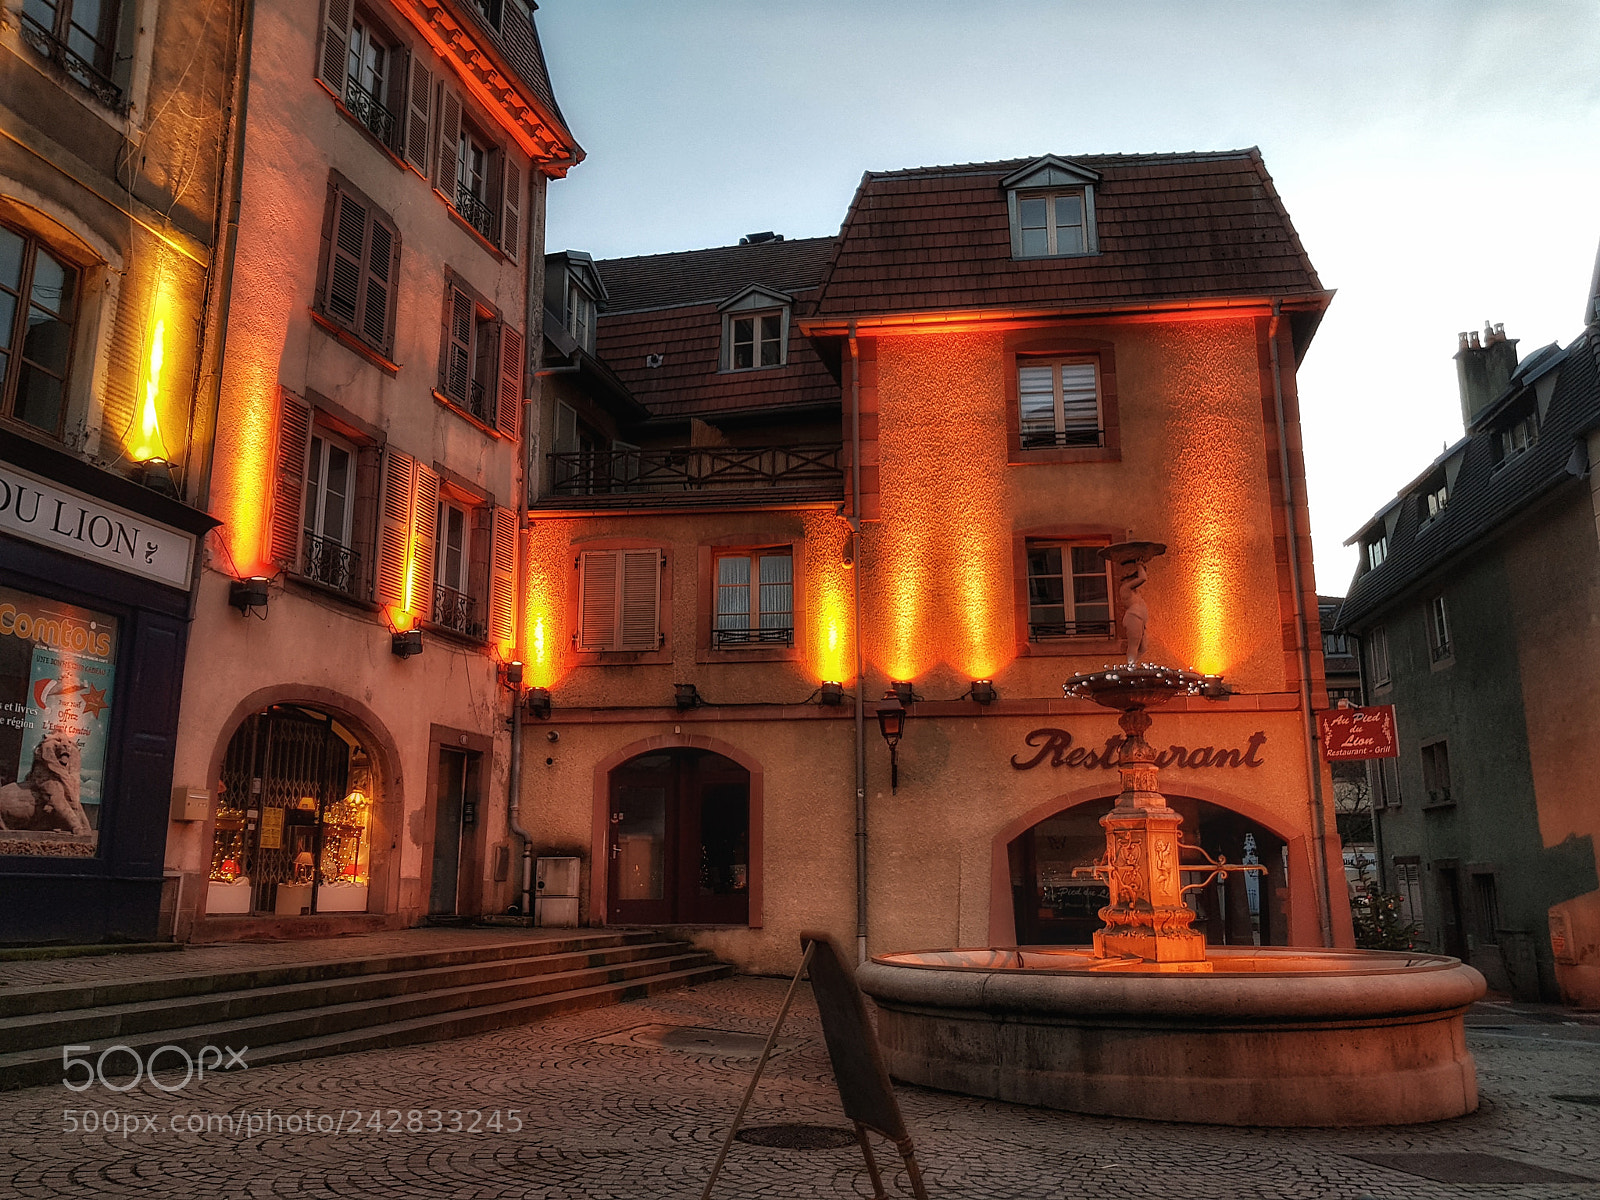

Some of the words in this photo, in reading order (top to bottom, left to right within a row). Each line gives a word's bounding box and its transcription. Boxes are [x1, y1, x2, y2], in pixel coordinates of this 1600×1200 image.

[50, 499, 141, 559] LION
[0, 603, 111, 657] Comtois
[4, 702, 13, 711] et
[15, 702, 38, 716] livres
[7, 716, 34, 729] région
[1330, 714, 1350, 727] Au
[1352, 711, 1381, 724] Pied
[1349, 724, 1364, 733] du
[1340, 734, 1375, 748] Lion
[1010, 728, 1268, 770] Resturant
[1326, 747, 1367, 757] Restaurant
[1374, 745, 1391, 754] Grill
